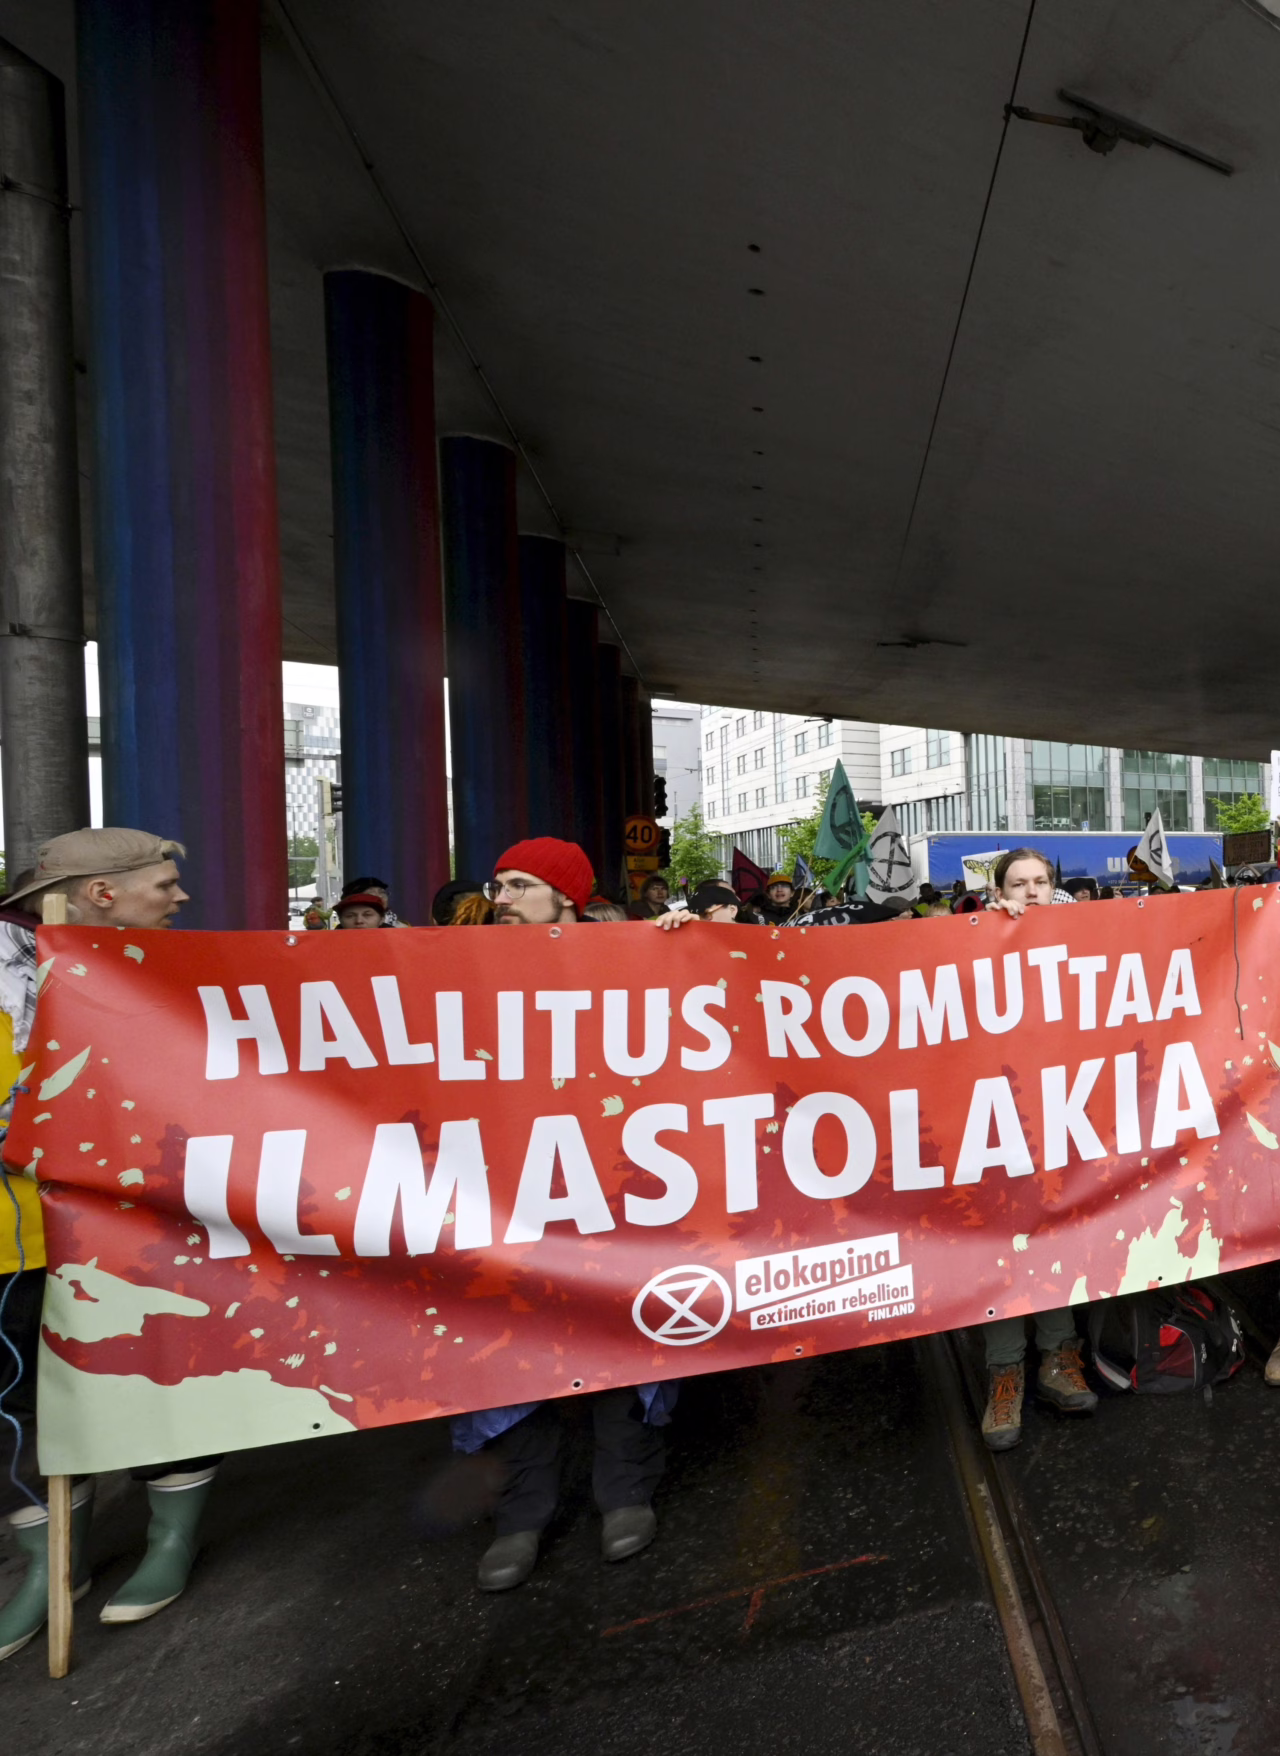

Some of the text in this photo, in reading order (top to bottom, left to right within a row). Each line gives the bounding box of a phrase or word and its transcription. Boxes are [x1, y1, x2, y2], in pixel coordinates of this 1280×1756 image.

[626, 824, 653, 844] 40
[197, 944, 1202, 1082] HALLITUS ROMUTTAA
[183, 1040, 1221, 1260] ILMASTOLAKIA
[744, 1247, 891, 1297] elokapina
[756, 1283, 910, 1326] extinction rebellion
[867, 1302, 916, 1323] FINLAND
